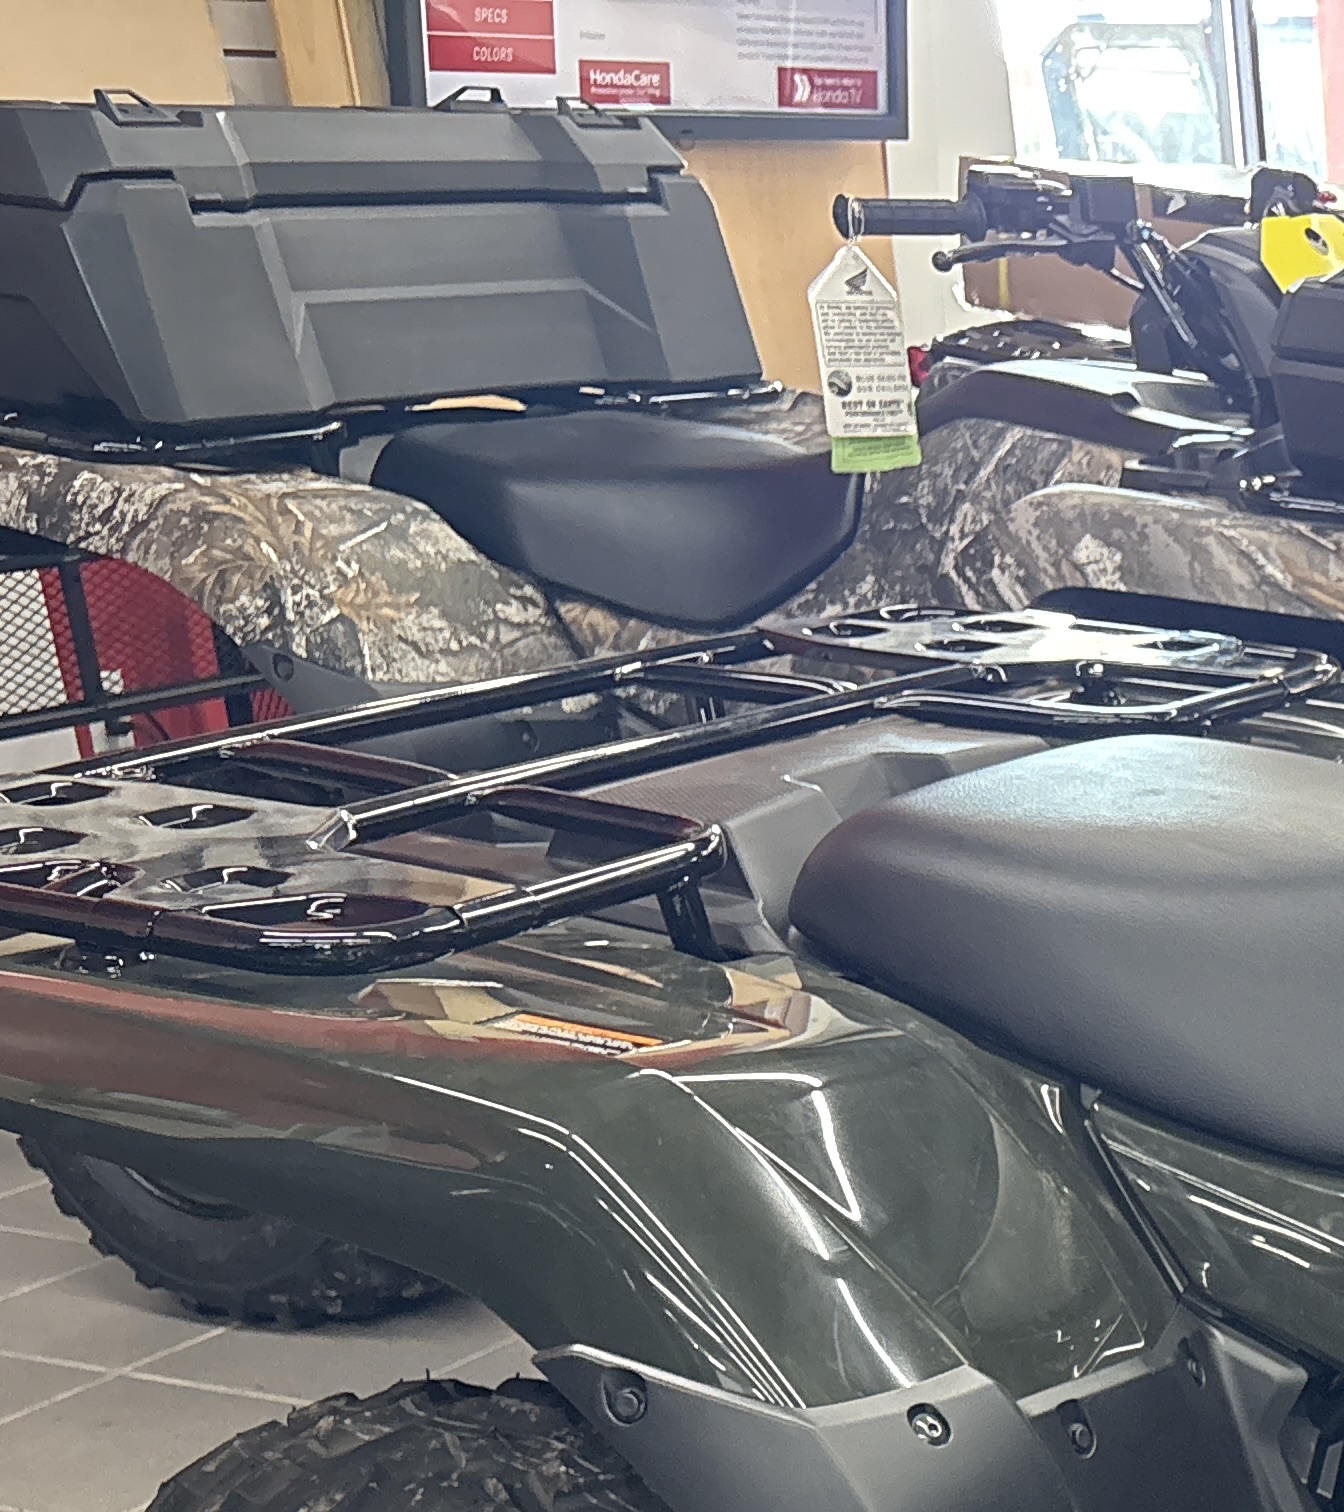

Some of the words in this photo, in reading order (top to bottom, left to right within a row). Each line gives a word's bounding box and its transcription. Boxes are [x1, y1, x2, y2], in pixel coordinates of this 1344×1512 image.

[474, 7, 508, 23] SPECS
[473, 46, 514, 62] COLORS
[589, 68, 660, 86] HondaCare
